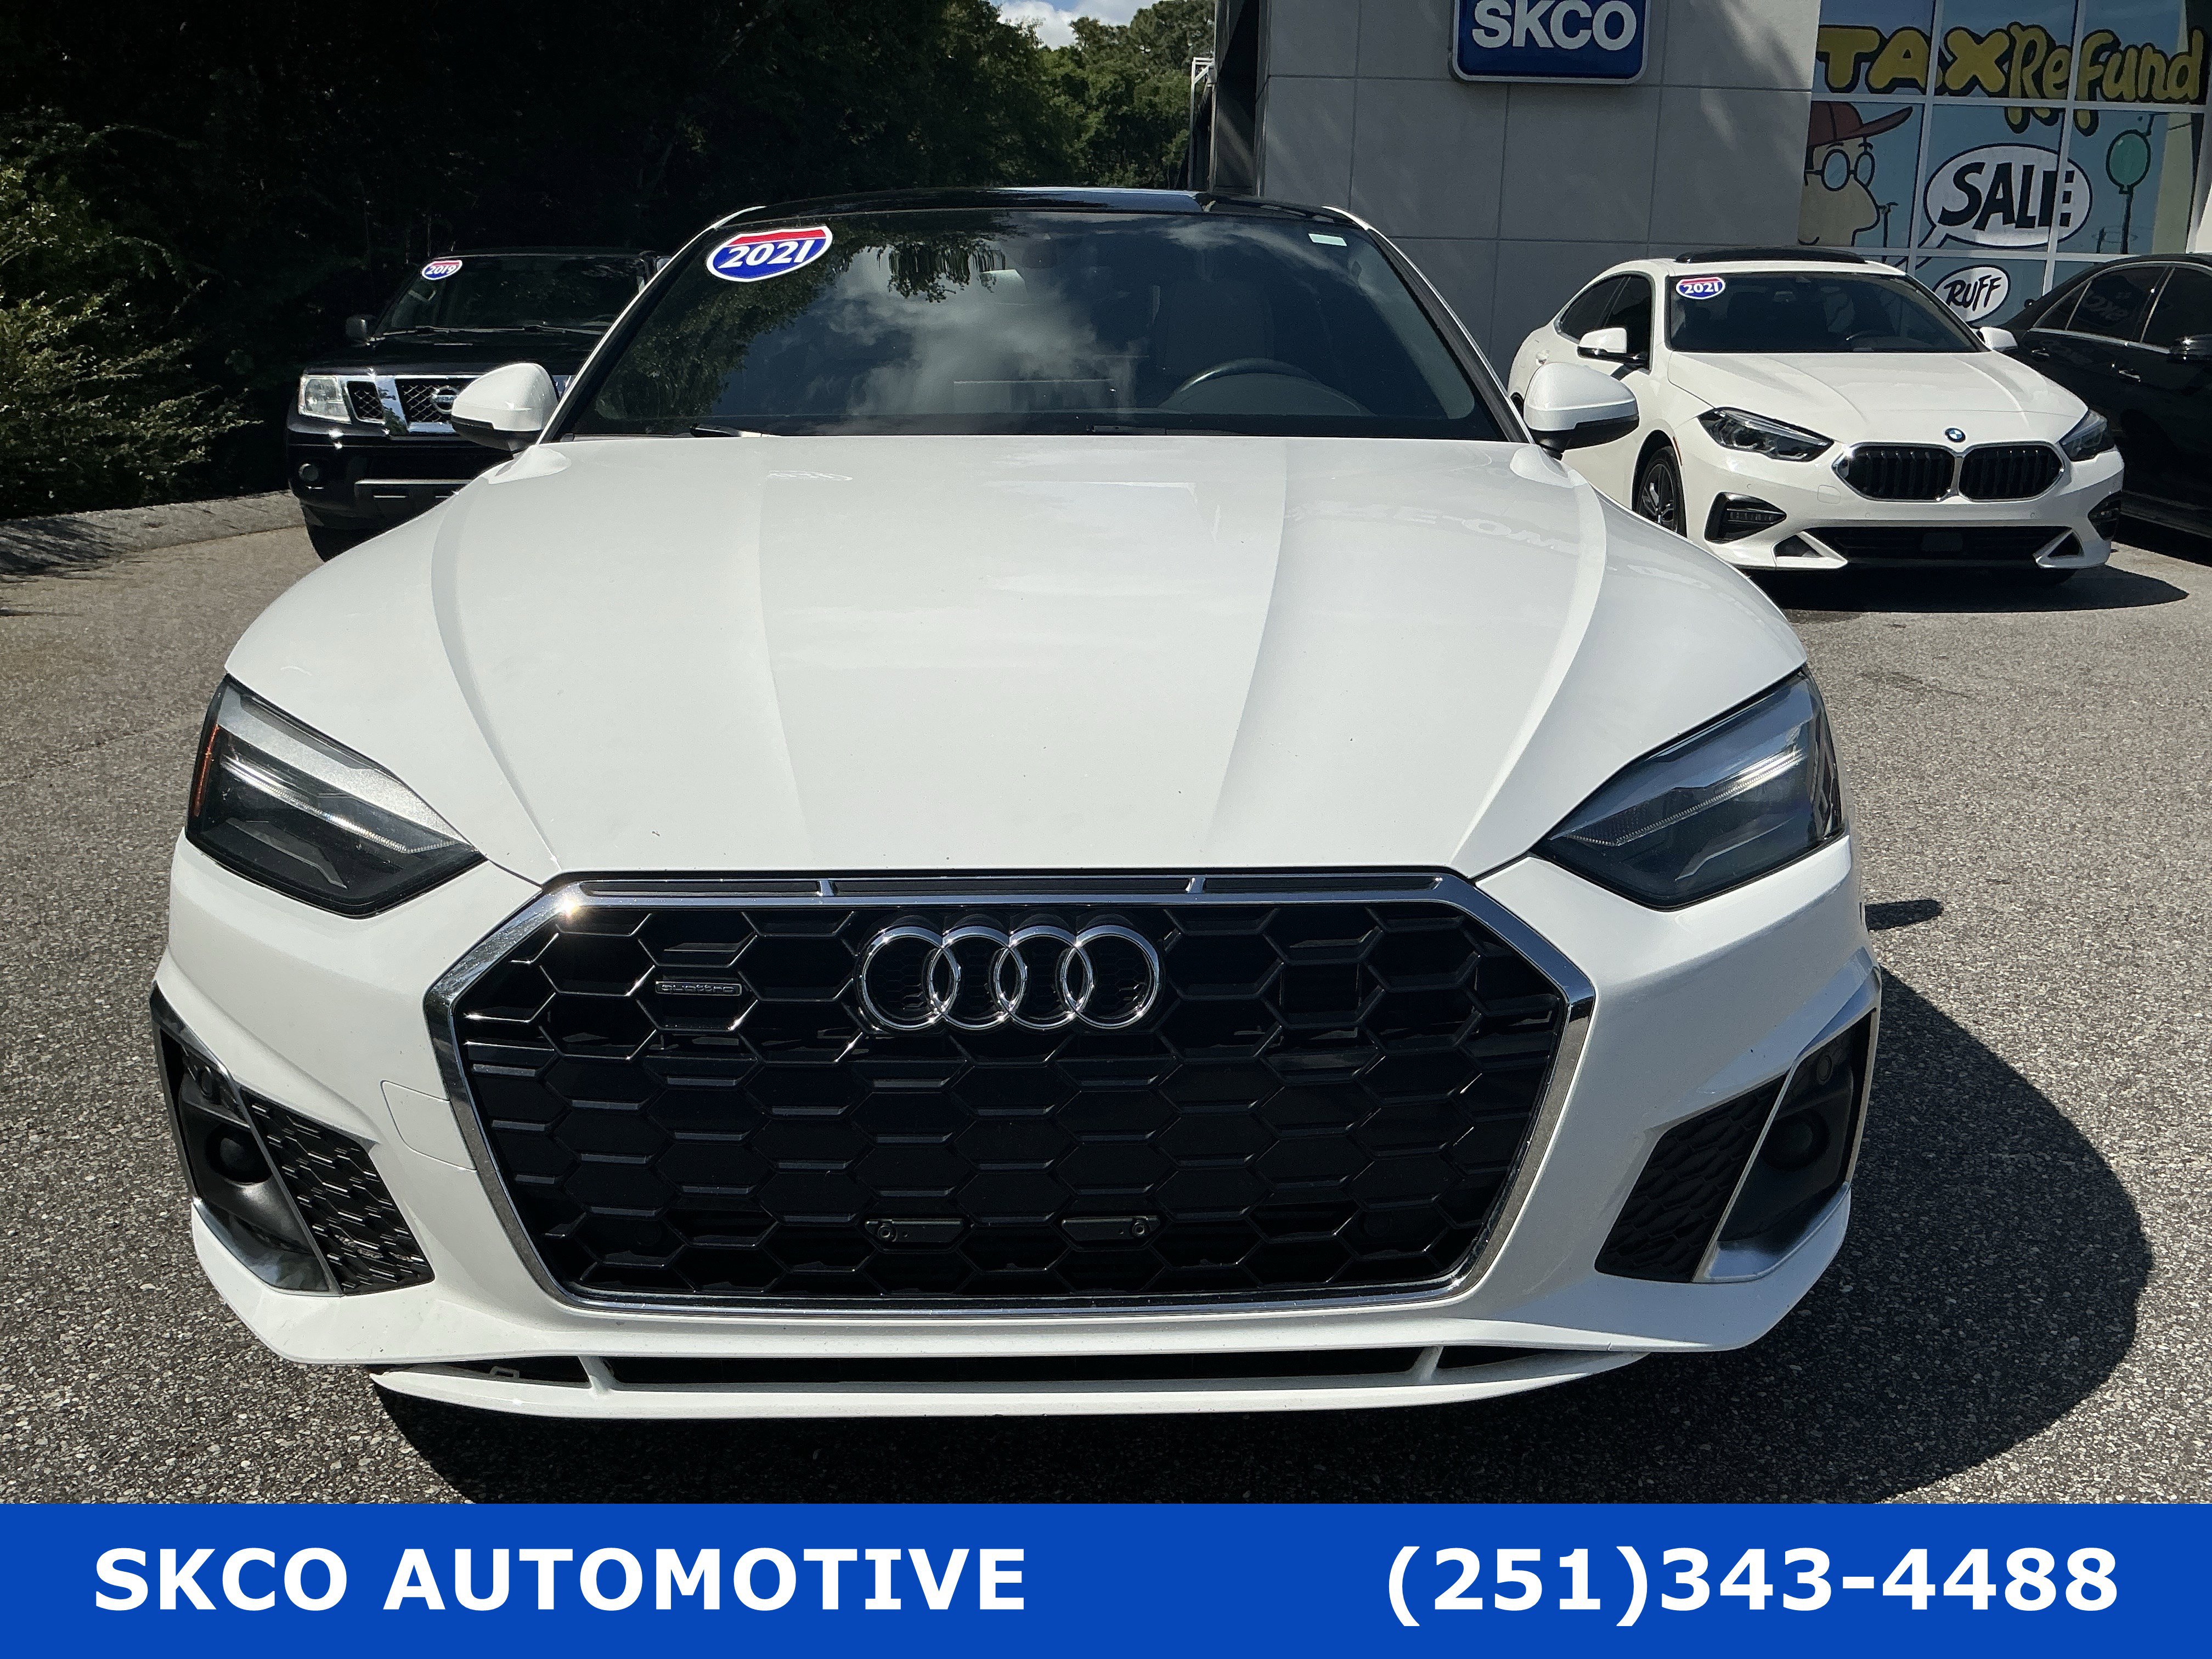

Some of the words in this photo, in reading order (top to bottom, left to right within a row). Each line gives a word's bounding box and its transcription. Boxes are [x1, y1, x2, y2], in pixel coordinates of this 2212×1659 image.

[1471, 0, 1637, 51] SKCO
[1815, 26, 2011, 97] TAX
[1937, 161, 2076, 232] SALE
[425, 264, 457, 275] 2019
[718, 239, 815, 269] 2021
[1683, 281, 1719, 294] 2021
[1943, 274, 2002, 312] RUFF
